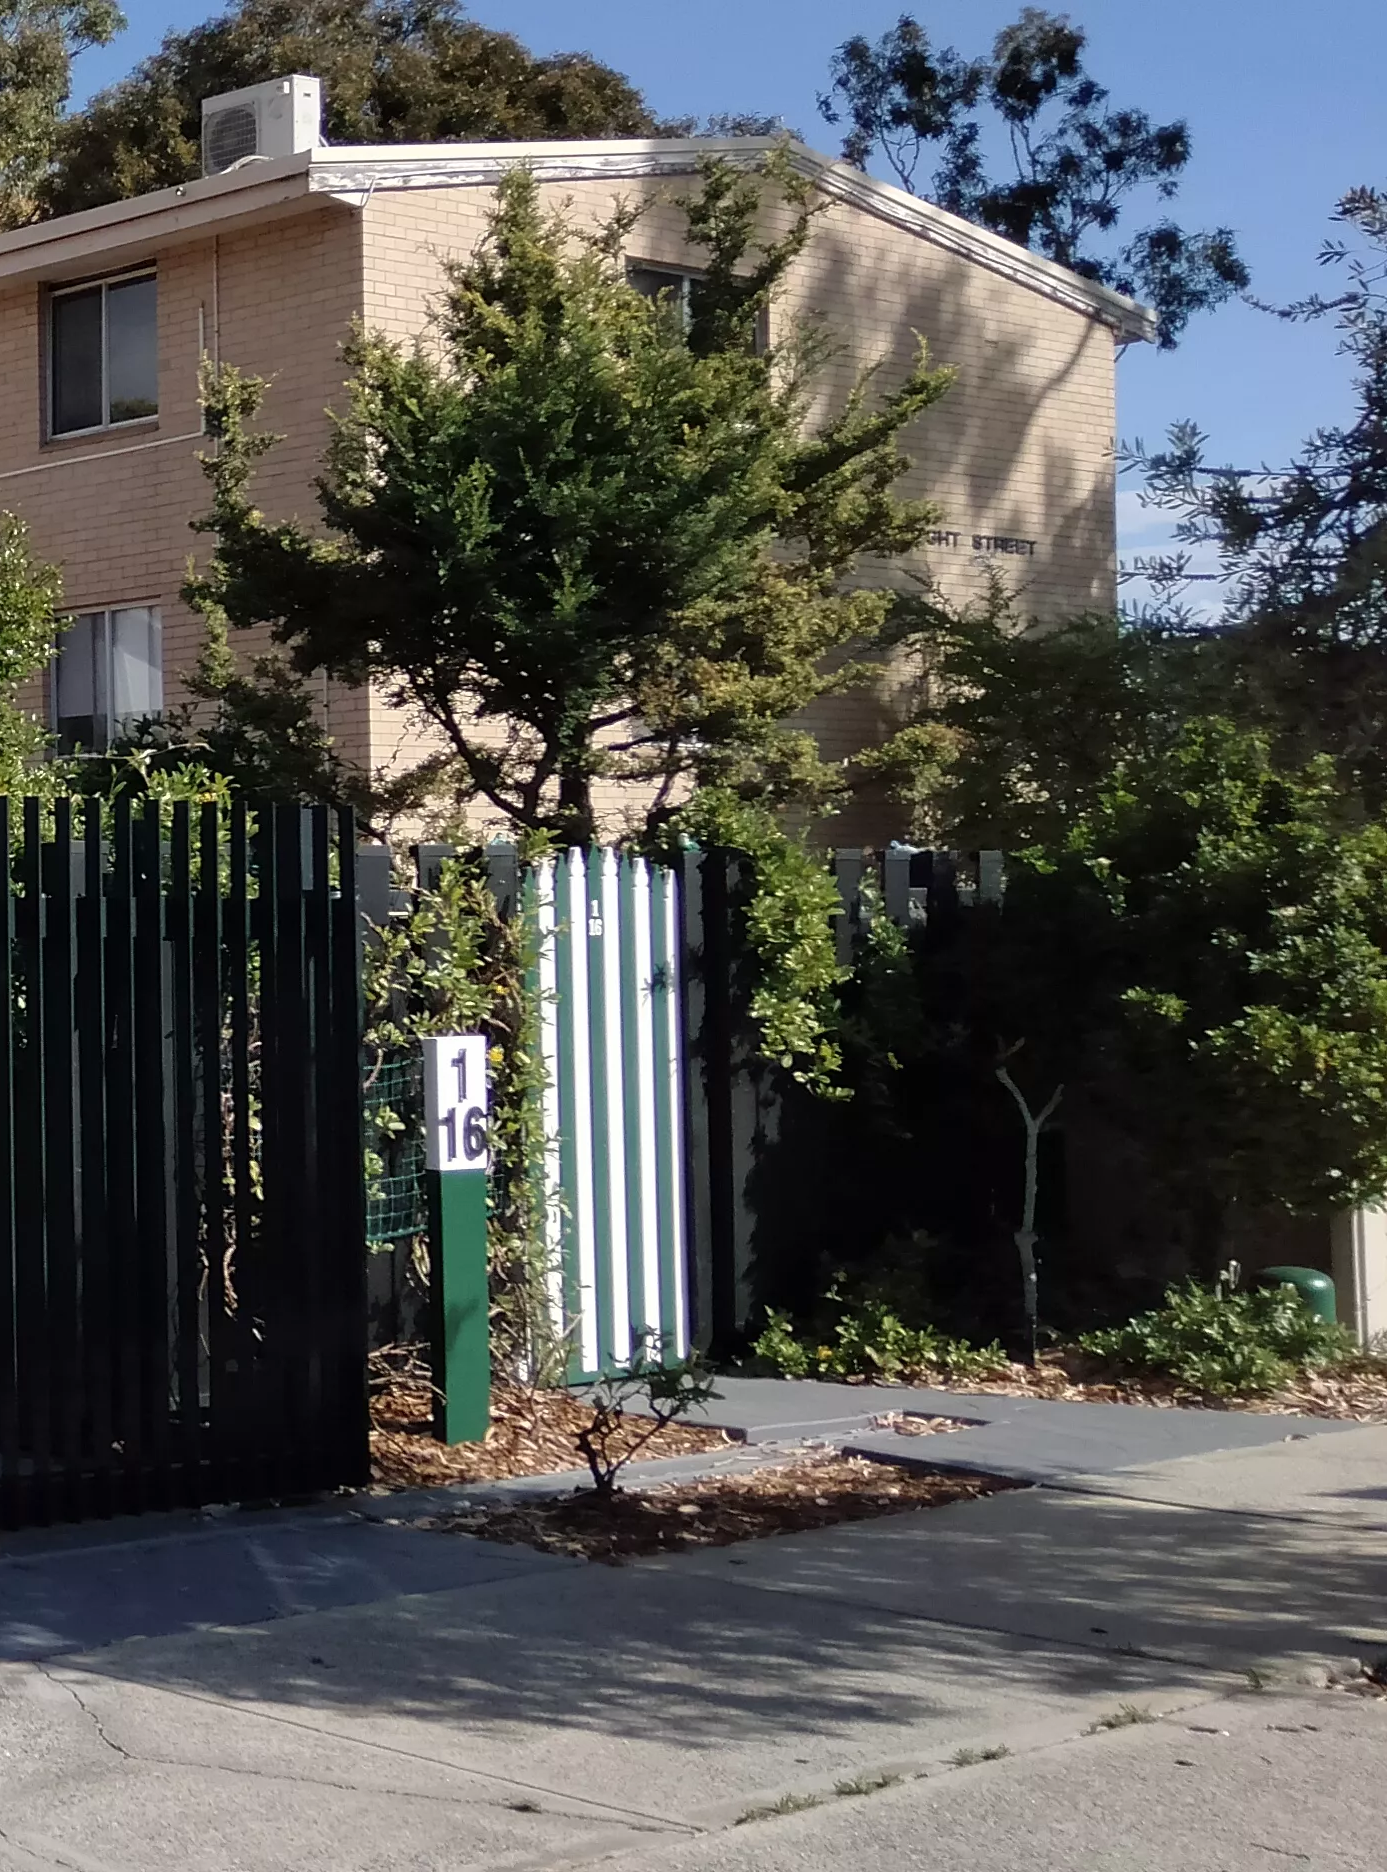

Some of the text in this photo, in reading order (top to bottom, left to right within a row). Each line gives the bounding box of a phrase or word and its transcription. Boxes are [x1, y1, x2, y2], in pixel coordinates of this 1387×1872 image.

[972, 534, 1037, 555] STREET
[591, 899, 599, 916] 1
[588, 918, 603, 936] 16
[451, 1049, 467, 1103] 1
[437, 1106, 488, 1162] 16
